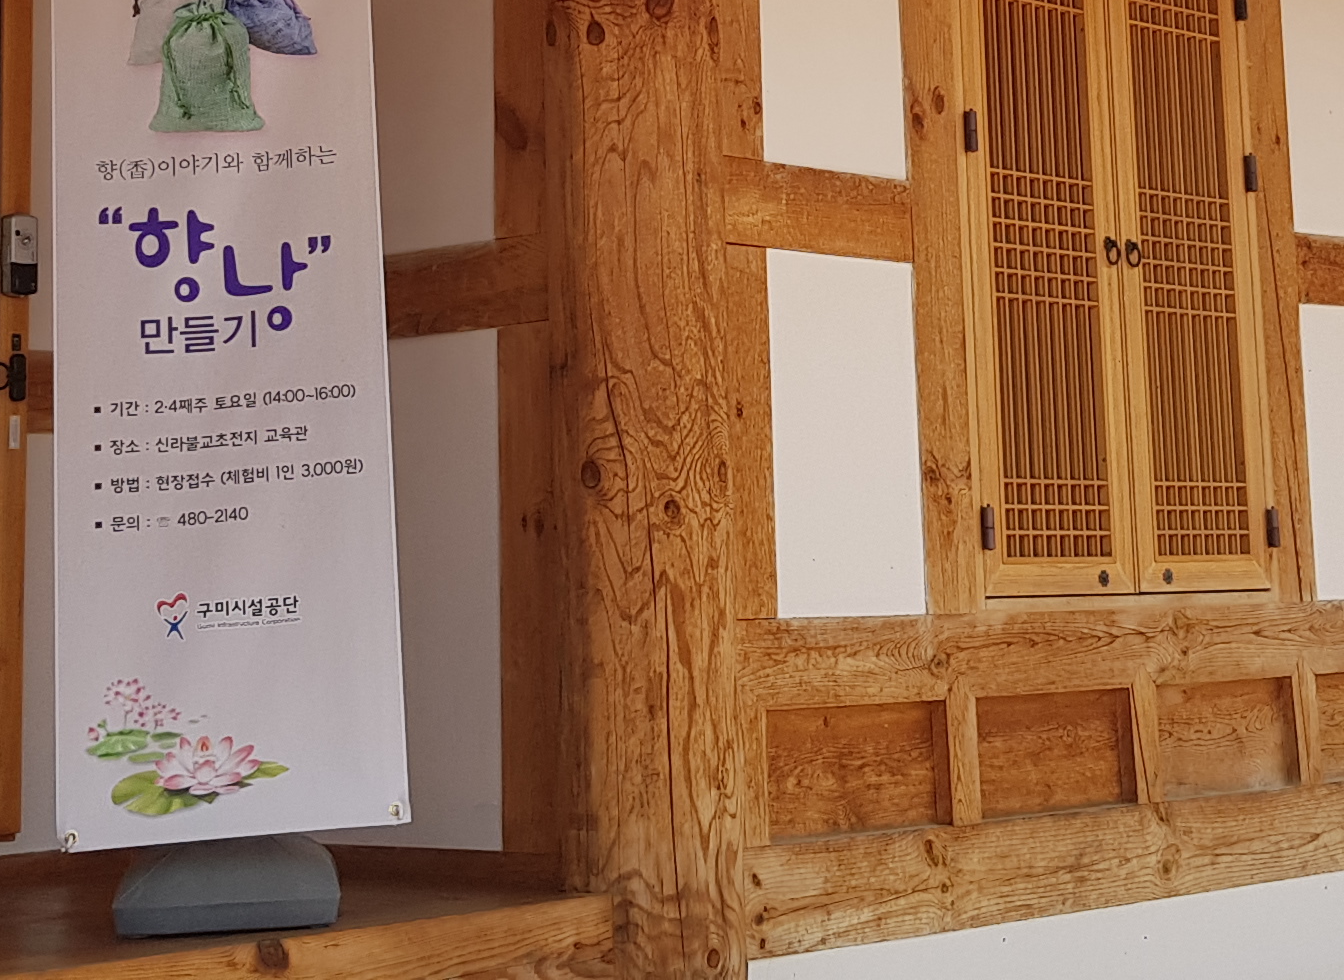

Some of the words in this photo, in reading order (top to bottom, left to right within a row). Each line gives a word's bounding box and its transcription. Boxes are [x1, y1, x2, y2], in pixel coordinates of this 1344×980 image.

[96, 152, 244, 181] 향(香)이야기와
[252, 145, 337, 172] 함께하는
[141, 310, 256, 354] 만들기
[110, 400, 140, 417] 기간
[213, 391, 257, 410] 토요일
[263, 384, 356, 406] (14:00~16:00)
[110, 440, 141, 455] 장소
[155, 430, 258, 453] 신라불교초전지
[264, 425, 308, 442] 교육관
[110, 477, 140, 494] 방법
[156, 472, 215, 492] 현장접수
[221, 466, 270, 486] (체험비
[276, 464, 295, 481] 1인
[110, 515, 140, 532] 문의
[177, 507, 249, 527] 480-2140
[197, 595, 299, 619] 구미시설공단
